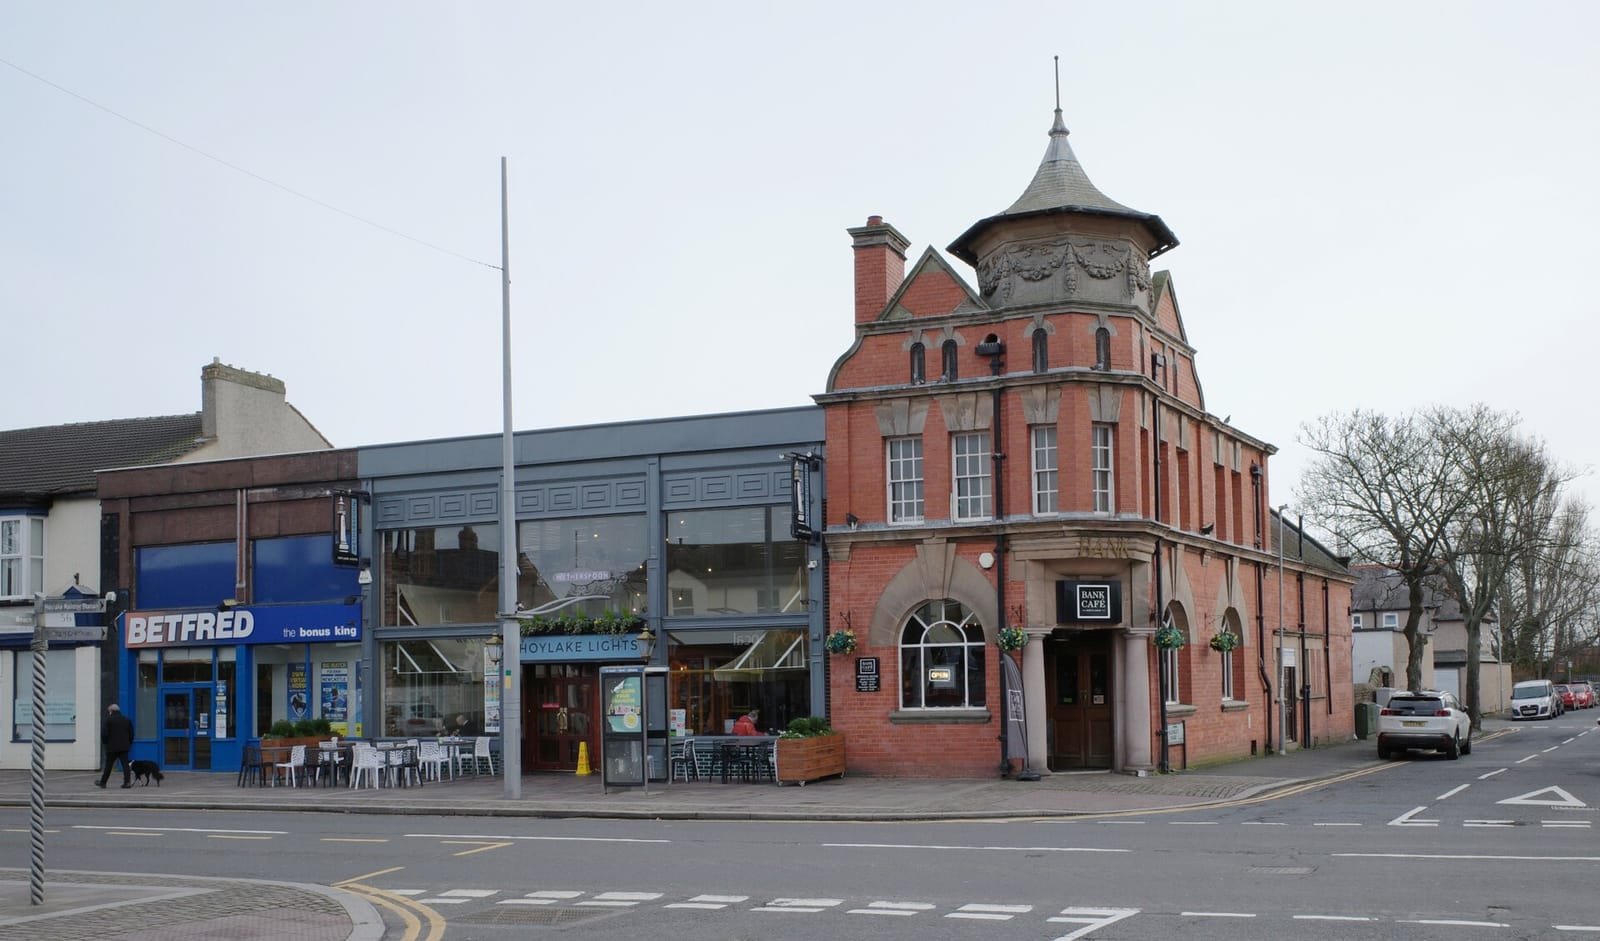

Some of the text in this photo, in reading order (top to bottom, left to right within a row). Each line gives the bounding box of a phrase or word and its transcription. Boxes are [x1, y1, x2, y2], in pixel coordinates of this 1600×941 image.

[1081, 591, 1105, 599] BANK
[128, 611, 254, 643] BETFRED
[283, 625, 357, 637] the bonus king
[520, 639, 638, 654] HOYLAKE LIGHTS
